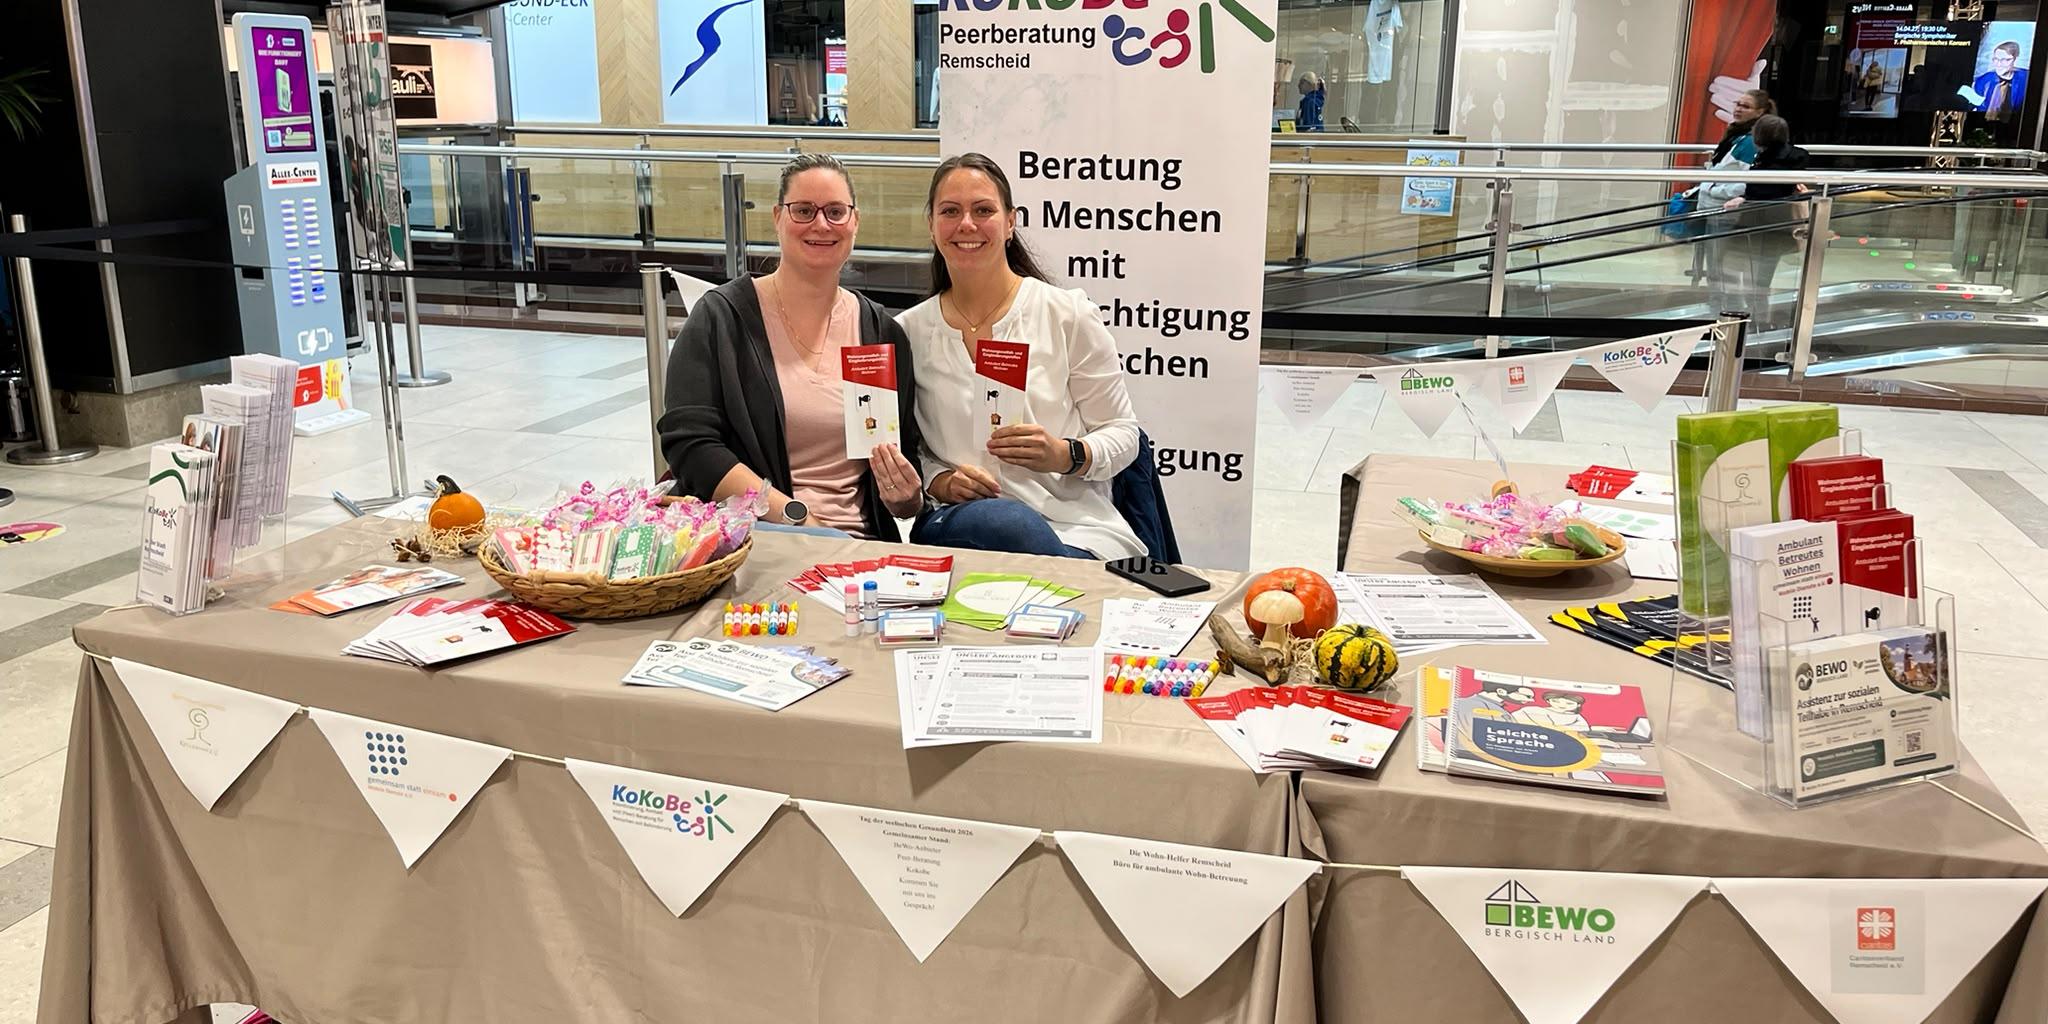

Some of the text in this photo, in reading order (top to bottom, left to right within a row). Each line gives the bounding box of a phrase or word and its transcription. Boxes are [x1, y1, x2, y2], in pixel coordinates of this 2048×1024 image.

[940, 23, 1096, 48] Peerberatung
[940, 53, 1030, 69] Remscheid
[1019, 151, 1182, 190] Beratung
[1043, 200, 1222, 233] Menschen
[1068, 250, 1126, 279] mit
[1098, 298, 1251, 341] chtigung
[1604, 346, 1653, 362] KoKoBe
[1413, 376, 1455, 390] BEWO
[1777, 535, 1823, 553] Ambulant
[1778, 548, 1824, 566] Betreutes
[1783, 562, 1821, 578] Wohnen
[1815, 660, 1848, 677] BEWO
[1797, 685, 1880, 710] Assistenz zur sozialen
[1486, 726, 1549, 740] Leichte
[1486, 735, 1555, 749] Sprache
[612, 784, 692, 814] KoKoBe
[859, 815, 872, 823] Tag
[885, 820, 917, 829] seelischen
[918, 823, 956, 834] Gesundheit
[957, 828, 974, 836] 2026
[882, 829, 927, 841] Gemeinsamer
[1129, 849, 1232, 869] Die Wohn-Helfer Remscheid
[1113, 859, 1248, 885] Büro für ambulante Wohn-Betreuung
[1514, 904, 1616, 933] BEWO
[1485, 928, 1616, 944] BERGISCH LAND
